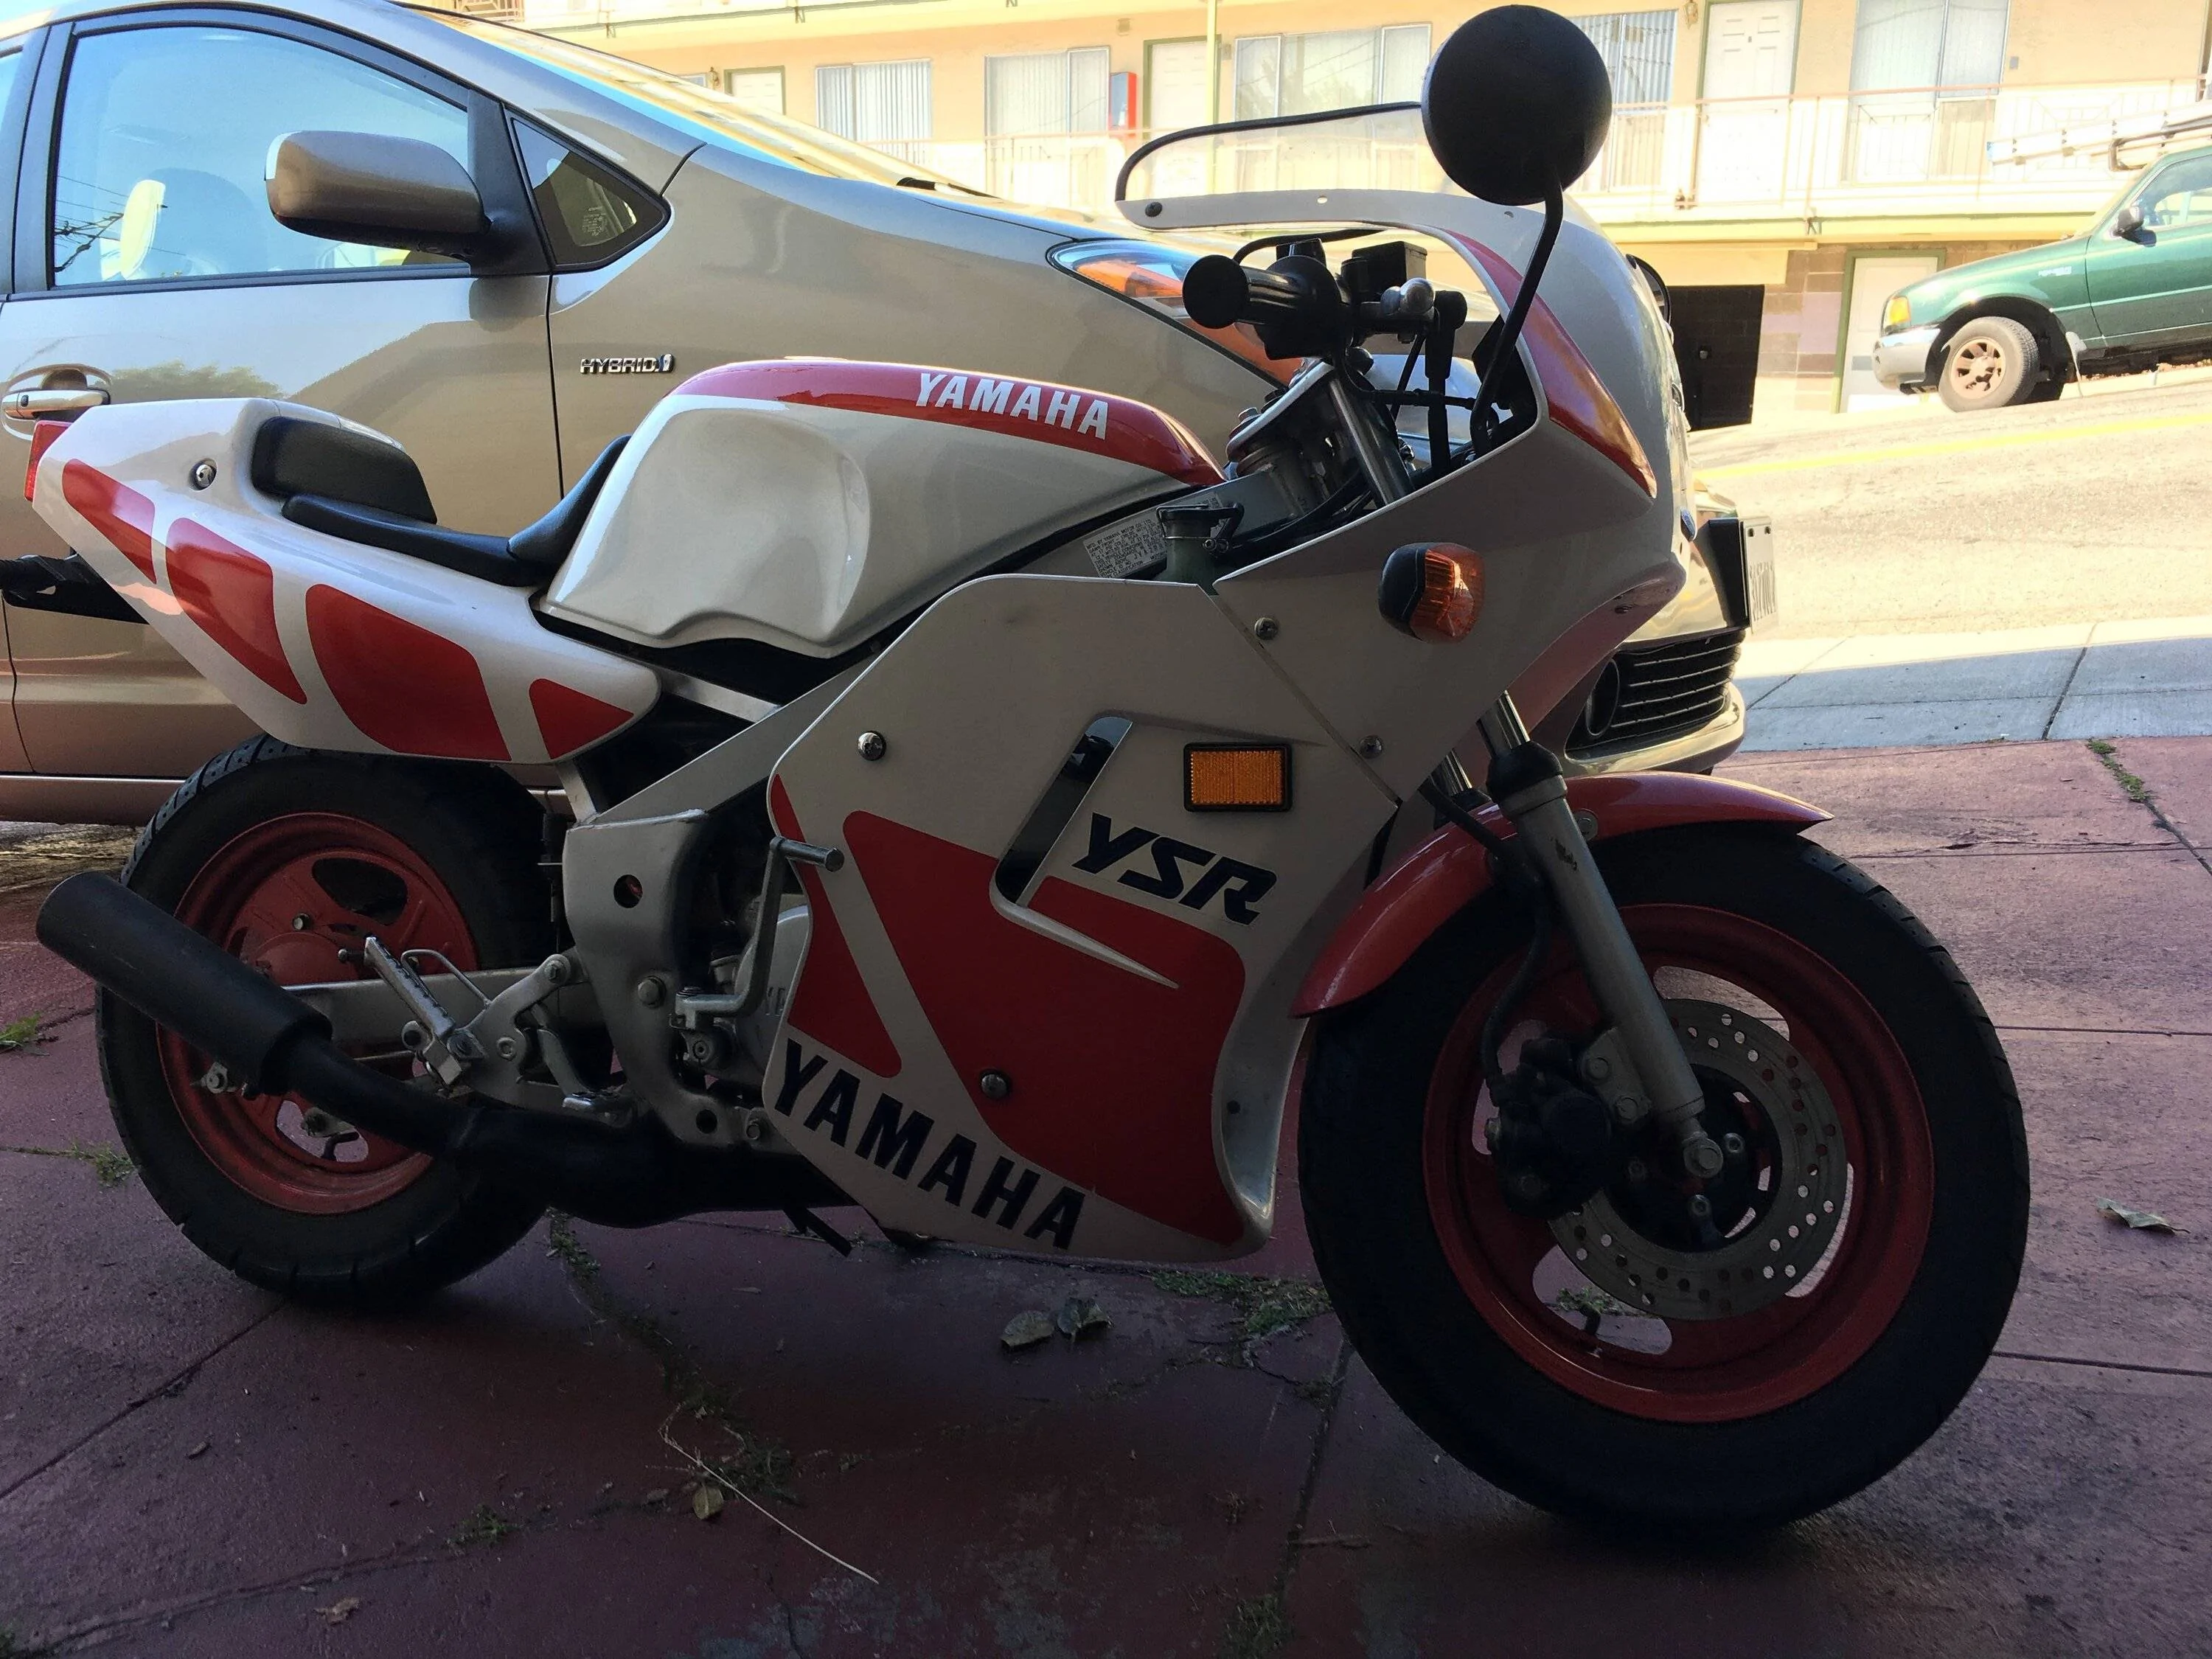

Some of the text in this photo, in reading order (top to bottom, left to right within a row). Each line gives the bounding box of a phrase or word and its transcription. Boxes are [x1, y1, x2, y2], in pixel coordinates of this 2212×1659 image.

[580, 358, 657, 374] HYBRID
[916, 372, 1108, 441] YAMAHA
[1071, 812, 1277, 925] YSR
[774, 1037, 1086, 1251] YAMAHA
